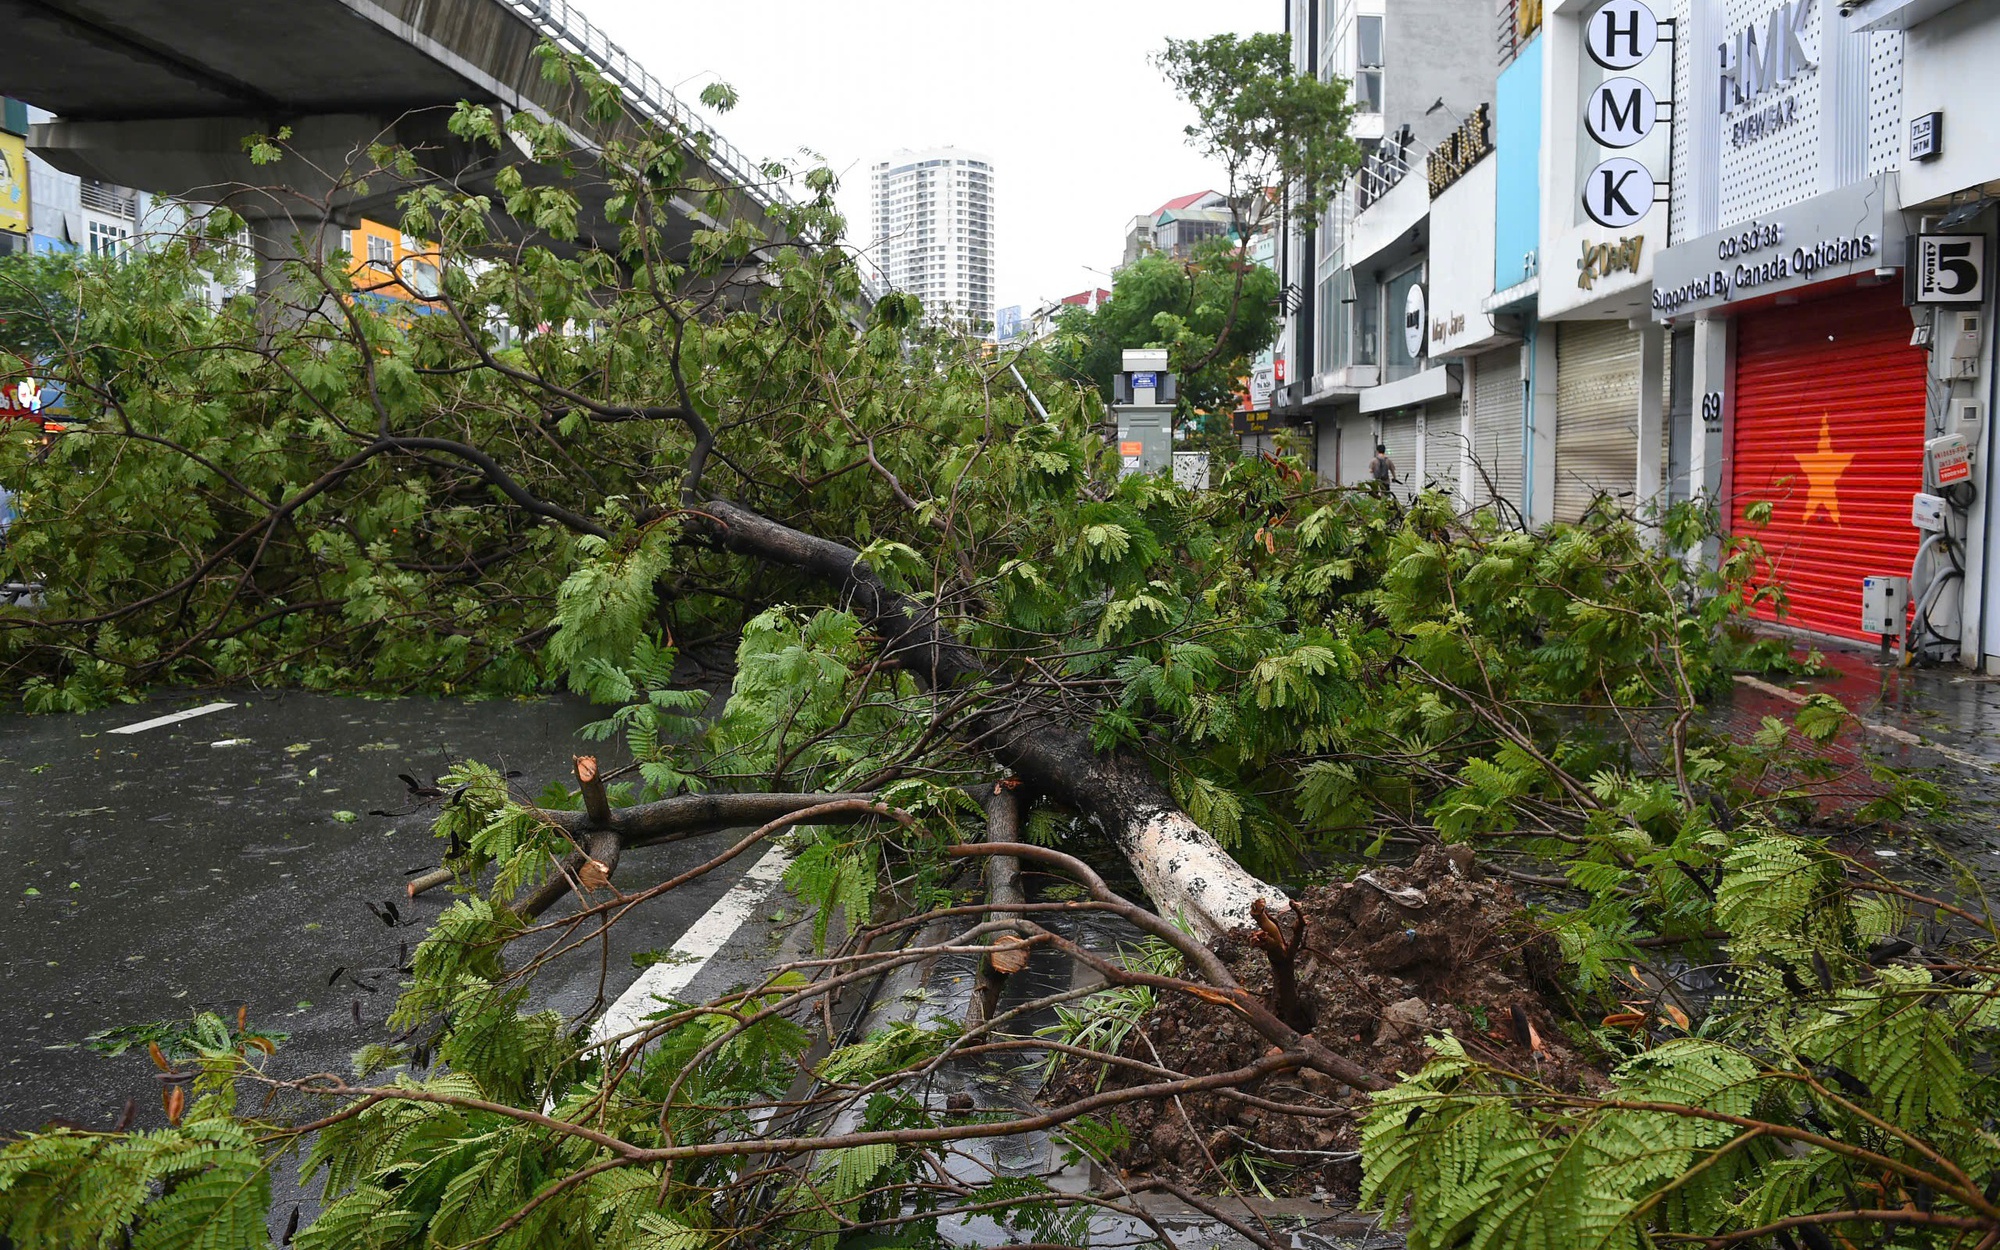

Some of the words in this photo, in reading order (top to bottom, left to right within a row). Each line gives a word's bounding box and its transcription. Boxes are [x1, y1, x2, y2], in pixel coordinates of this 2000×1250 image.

[1718, 0, 1817, 115] HMK
[1732, 95, 1798, 146] EYEWEAR
[1912, 138, 1930, 153] HTM
[1763, 223, 1778, 247] 38
[1652, 273, 1710, 313] Supported
[1714, 271, 1731, 300] By
[1735, 254, 1787, 288] Canada
[1792, 235, 1872, 280] Opticians
[1922, 241, 1936, 296] Twenty
[1702, 392, 1720, 422] 69
